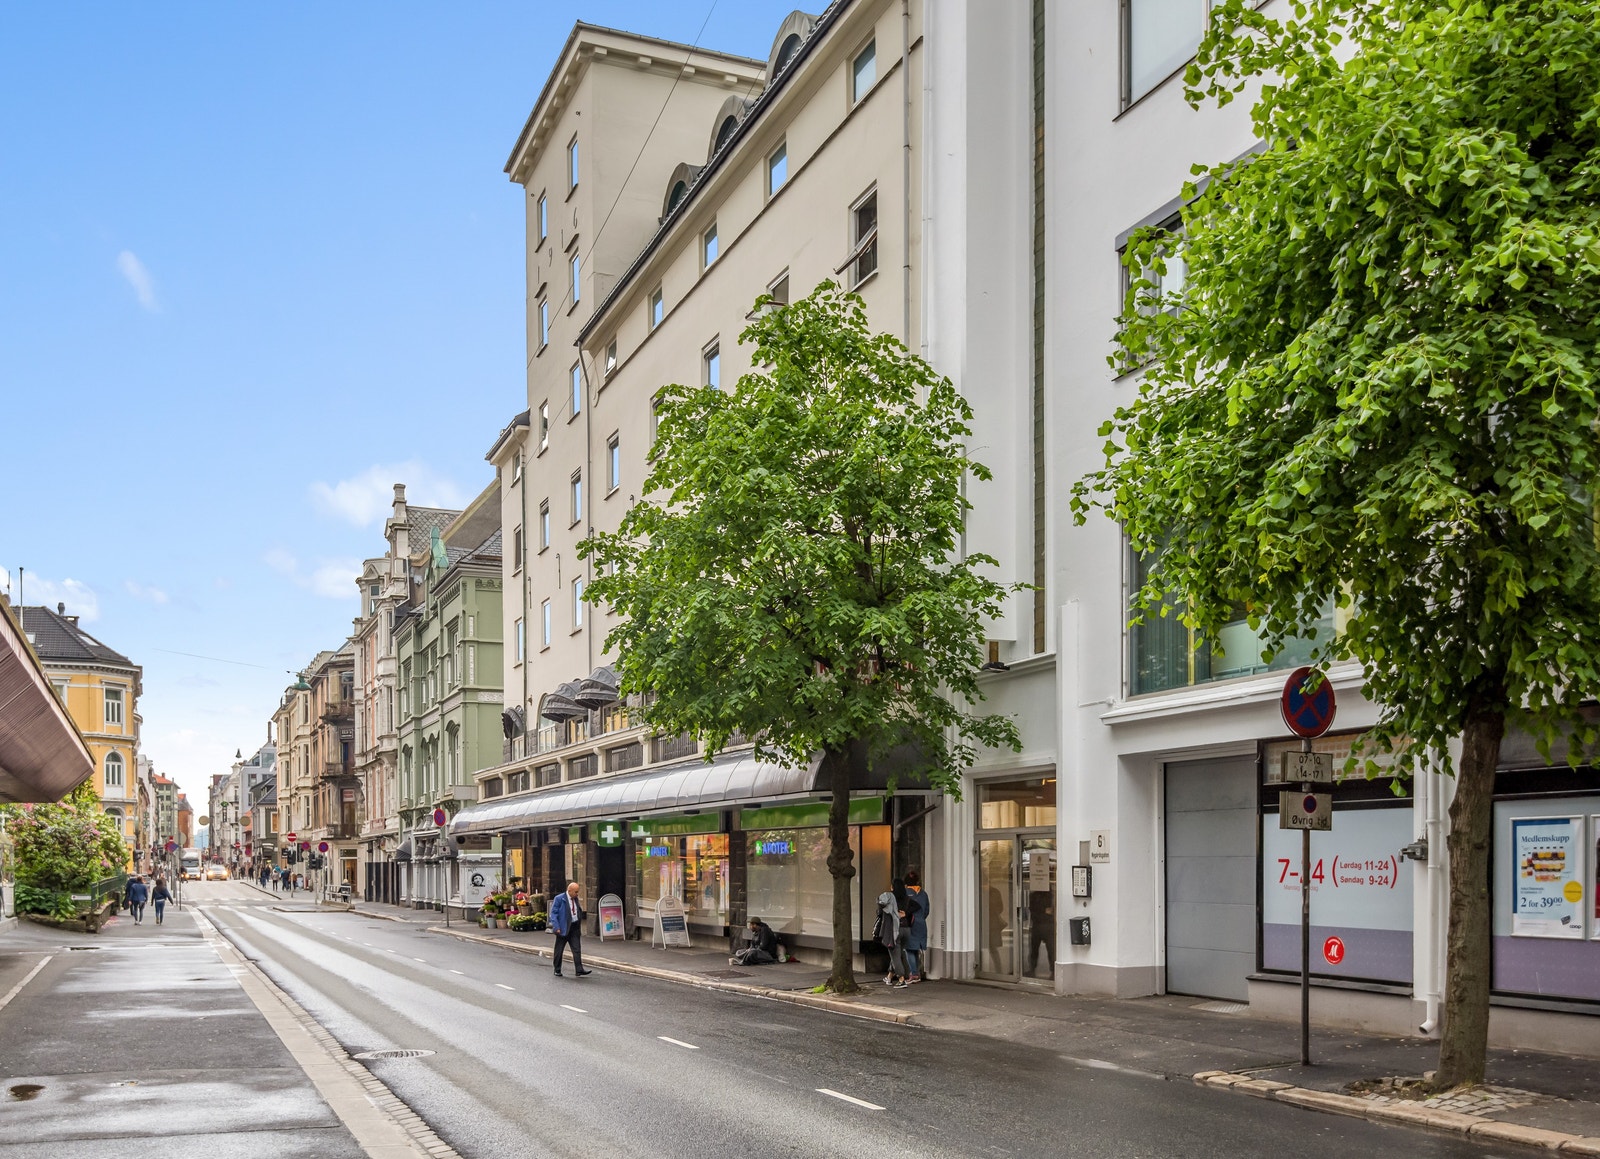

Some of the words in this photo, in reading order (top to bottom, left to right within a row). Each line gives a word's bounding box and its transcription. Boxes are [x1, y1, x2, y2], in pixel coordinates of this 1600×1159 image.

[1291, 815, 1314, 827] Øvrig
[1521, 835, 1570, 843] Medlemskupp
[763, 841, 789, 854] APOTEK
[1340, 861, 1362, 870] Lørdag
[1364, 860, 1389, 871] 11-24
[1340, 876, 1364, 885] Søndag
[1368, 875, 1389, 886] 9-24
[1520, 897, 1527, 908] 2
[1528, 900, 1539, 908] for
